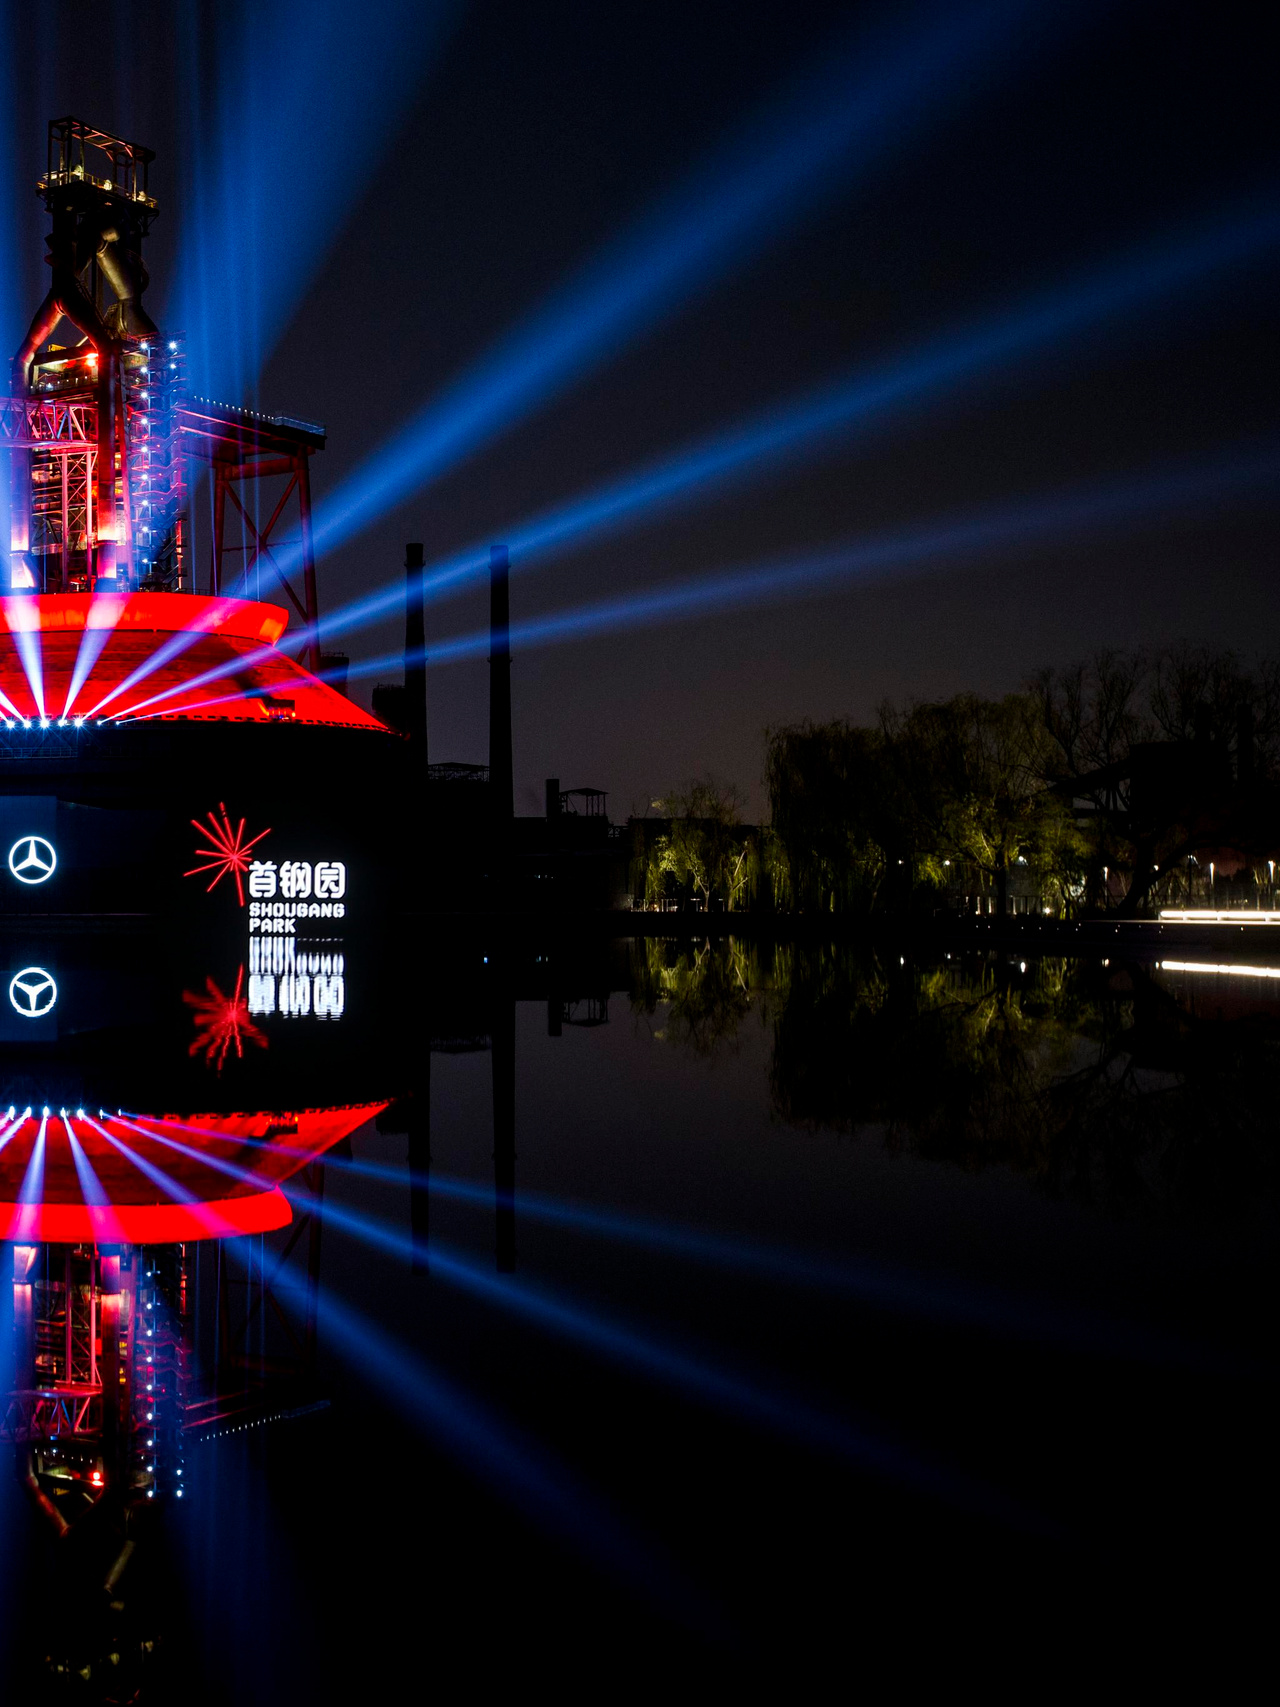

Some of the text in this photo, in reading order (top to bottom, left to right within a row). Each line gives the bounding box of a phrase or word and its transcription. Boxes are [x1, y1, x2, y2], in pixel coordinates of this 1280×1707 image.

[248, 860, 346, 898] 首钢园
[248, 902, 345, 918] SHOUGANG
[248, 918, 296, 933] PARK
